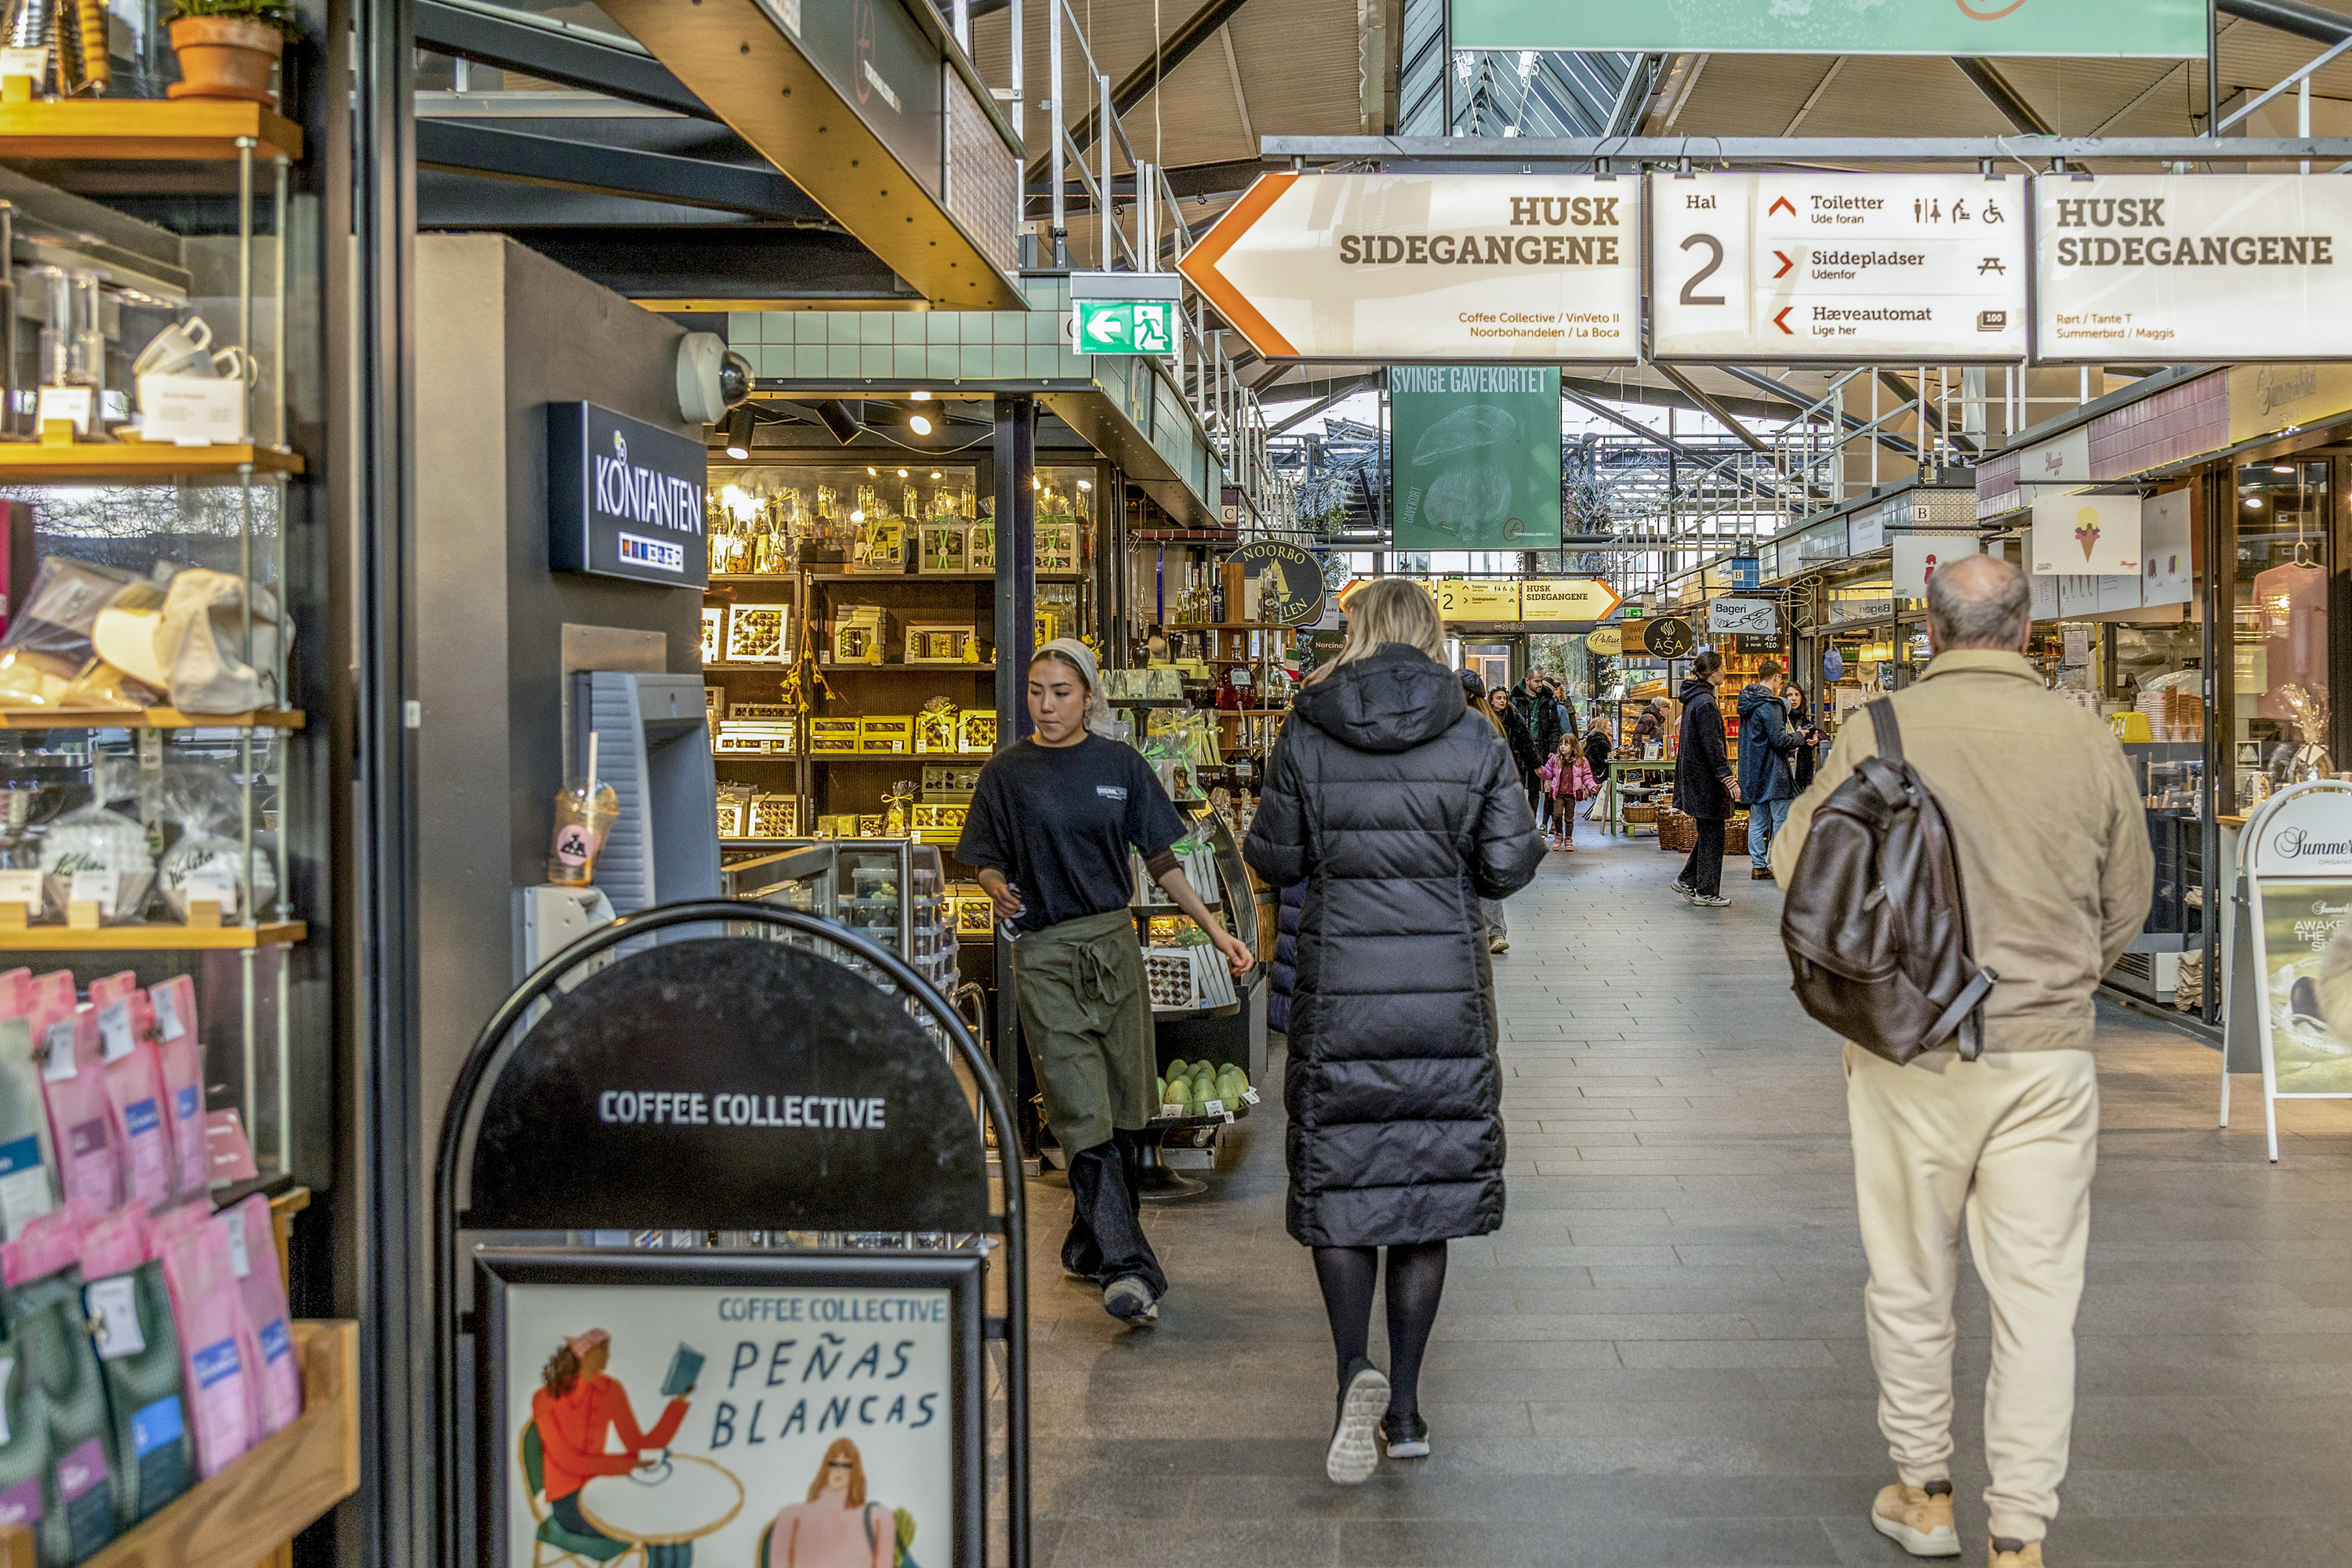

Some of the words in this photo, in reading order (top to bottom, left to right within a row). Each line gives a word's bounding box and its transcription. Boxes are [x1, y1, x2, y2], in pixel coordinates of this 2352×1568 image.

[1686, 195, 1717, 209] Hal
[1811, 195, 1884, 209] Toiletter
[1510, 197, 1619, 226] HUSK
[1811, 213, 1833, 224] Ude
[1836, 212, 1864, 224] foran
[2057, 198, 2165, 227] HUSK
[1340, 235, 1619, 265] SIDEGANGENE
[2057, 237, 2333, 266] SIDEGANGENE
[1812, 251, 1925, 269] Siddepladser
[1679, 234, 1726, 305] 2
[1812, 269, 1856, 280] Udenfor
[1459, 312, 1495, 323] Coffee
[1498, 312, 1555, 323] Collective
[1566, 313, 1607, 323] VinVeto
[1813, 307, 1932, 321] Hæveautomat
[2056, 314, 2080, 325] Rørt
[2091, 314, 2122, 325] Tante
[2125, 314, 2132, 324] T
[1470, 327, 1564, 338] Noorbohandelen
[1577, 328, 1588, 338] La
[1591, 328, 1620, 338] Boca
[1813, 325, 1835, 337] Lige
[1838, 325, 1857, 336] her
[2056, 328, 2125, 339] Summerbird
[2136, 328, 2175, 340] Maggis
[1392, 367, 1446, 393] SVINGE
[1450, 367, 1547, 393] GAVEKORTET
[596, 455, 702, 536] KONTANTEN
[1403, 486, 1422, 524] GAVEKORT
[1225, 508, 1234, 520] C
[1918, 508, 1927, 519] B
[1243, 545, 1305, 564] NOORBO
[1443, 593, 1454, 609] 2
[1715, 603, 1747, 615] Bageri
[2294, 931, 2326, 942] THE
[600, 1089, 708, 1125] COFFEE
[713, 1093, 886, 1130] COLLECTIVE
[718, 1297, 803, 1323] COFFEE
[809, 1298, 946, 1323] COLLECTIVE
[728, 1333, 915, 1389] PEÑAS
[710, 1392, 939, 1450] BLANCAS
